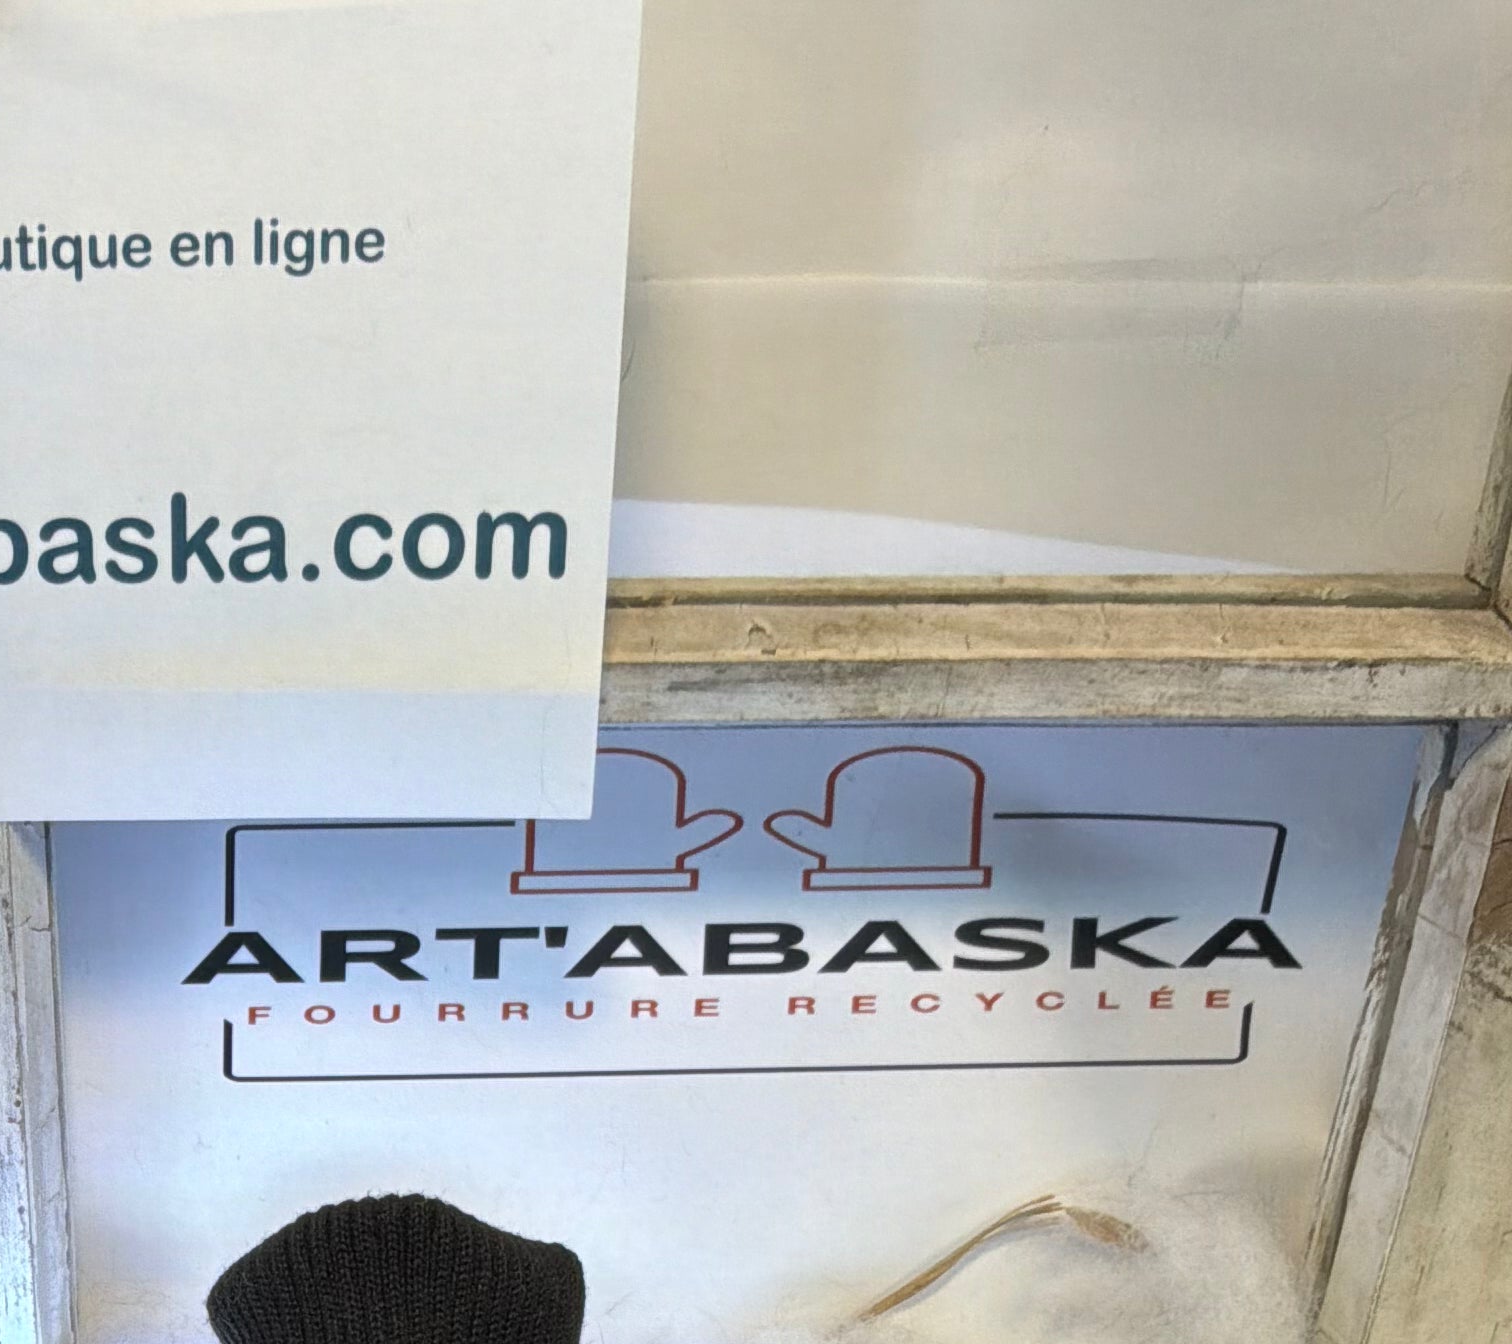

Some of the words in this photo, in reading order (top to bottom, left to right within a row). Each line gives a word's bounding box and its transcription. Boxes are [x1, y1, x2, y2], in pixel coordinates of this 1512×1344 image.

[170, 231, 234, 268] en
[254, 218, 386, 278] ligne
[181, 915, 1302, 985] ART'ABASKA
[247, 996, 723, 1026] FOURRURE
[787, 985, 1235, 1015] RECYCLÉE
